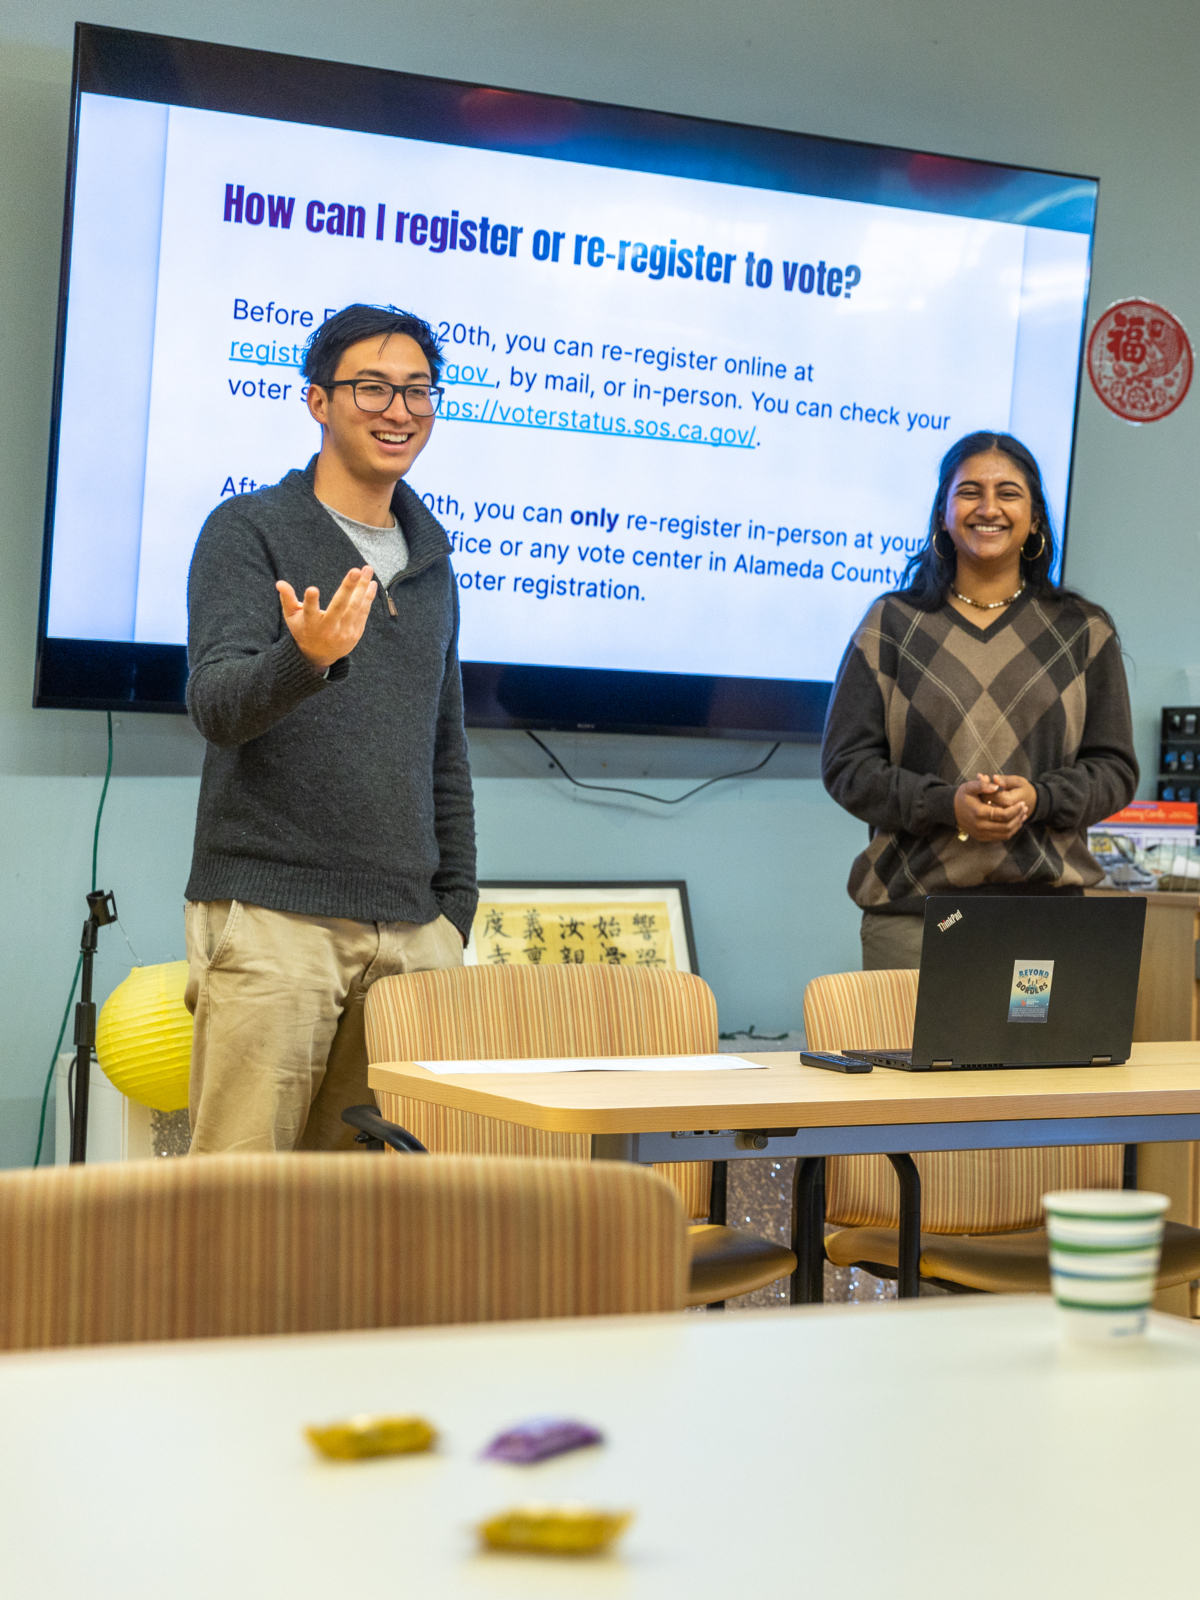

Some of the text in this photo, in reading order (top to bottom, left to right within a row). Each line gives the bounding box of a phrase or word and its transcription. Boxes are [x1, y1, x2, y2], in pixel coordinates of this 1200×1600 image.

[223, 183, 861, 299] How can I register or re-register to vote?
[234, 298, 314, 327] Before
[438, 321, 497, 352] 20th,
[506, 333, 546, 354] you
[554, 339, 593, 358] can
[602, 344, 717, 371] re-register
[725, 356, 787, 379] online
[794, 364, 814, 382] at
[1107, 312, 1147, 365] 福
[228, 378, 292, 400] voter
[230, 340, 305, 366] regist
[510, 366, 537, 392] by
[544, 373, 595, 398] mail,
[603, 380, 626, 397] or
[633, 379, 742, 409] in-person.
[752, 391, 789, 414] You
[796, 400, 833, 418] can
[840, 402, 900, 426] check
[907, 412, 951, 432] your
[220, 476, 924, 555] Aft 0th, you can only re-register in-person at your
[500, 540, 523, 557] or
[530, 543, 570, 565] any
[578, 544, 625, 564] vote
[632, 550, 703, 570] center
[709, 551, 726, 572] in
[733, 554, 824, 579] Alameda
[456, 571, 645, 601] oter registration.
[937, 909, 963, 932] ThinkPad
[1016, 980, 1048, 994] BORDERS
[1018, 968, 1049, 978] BEYOND
